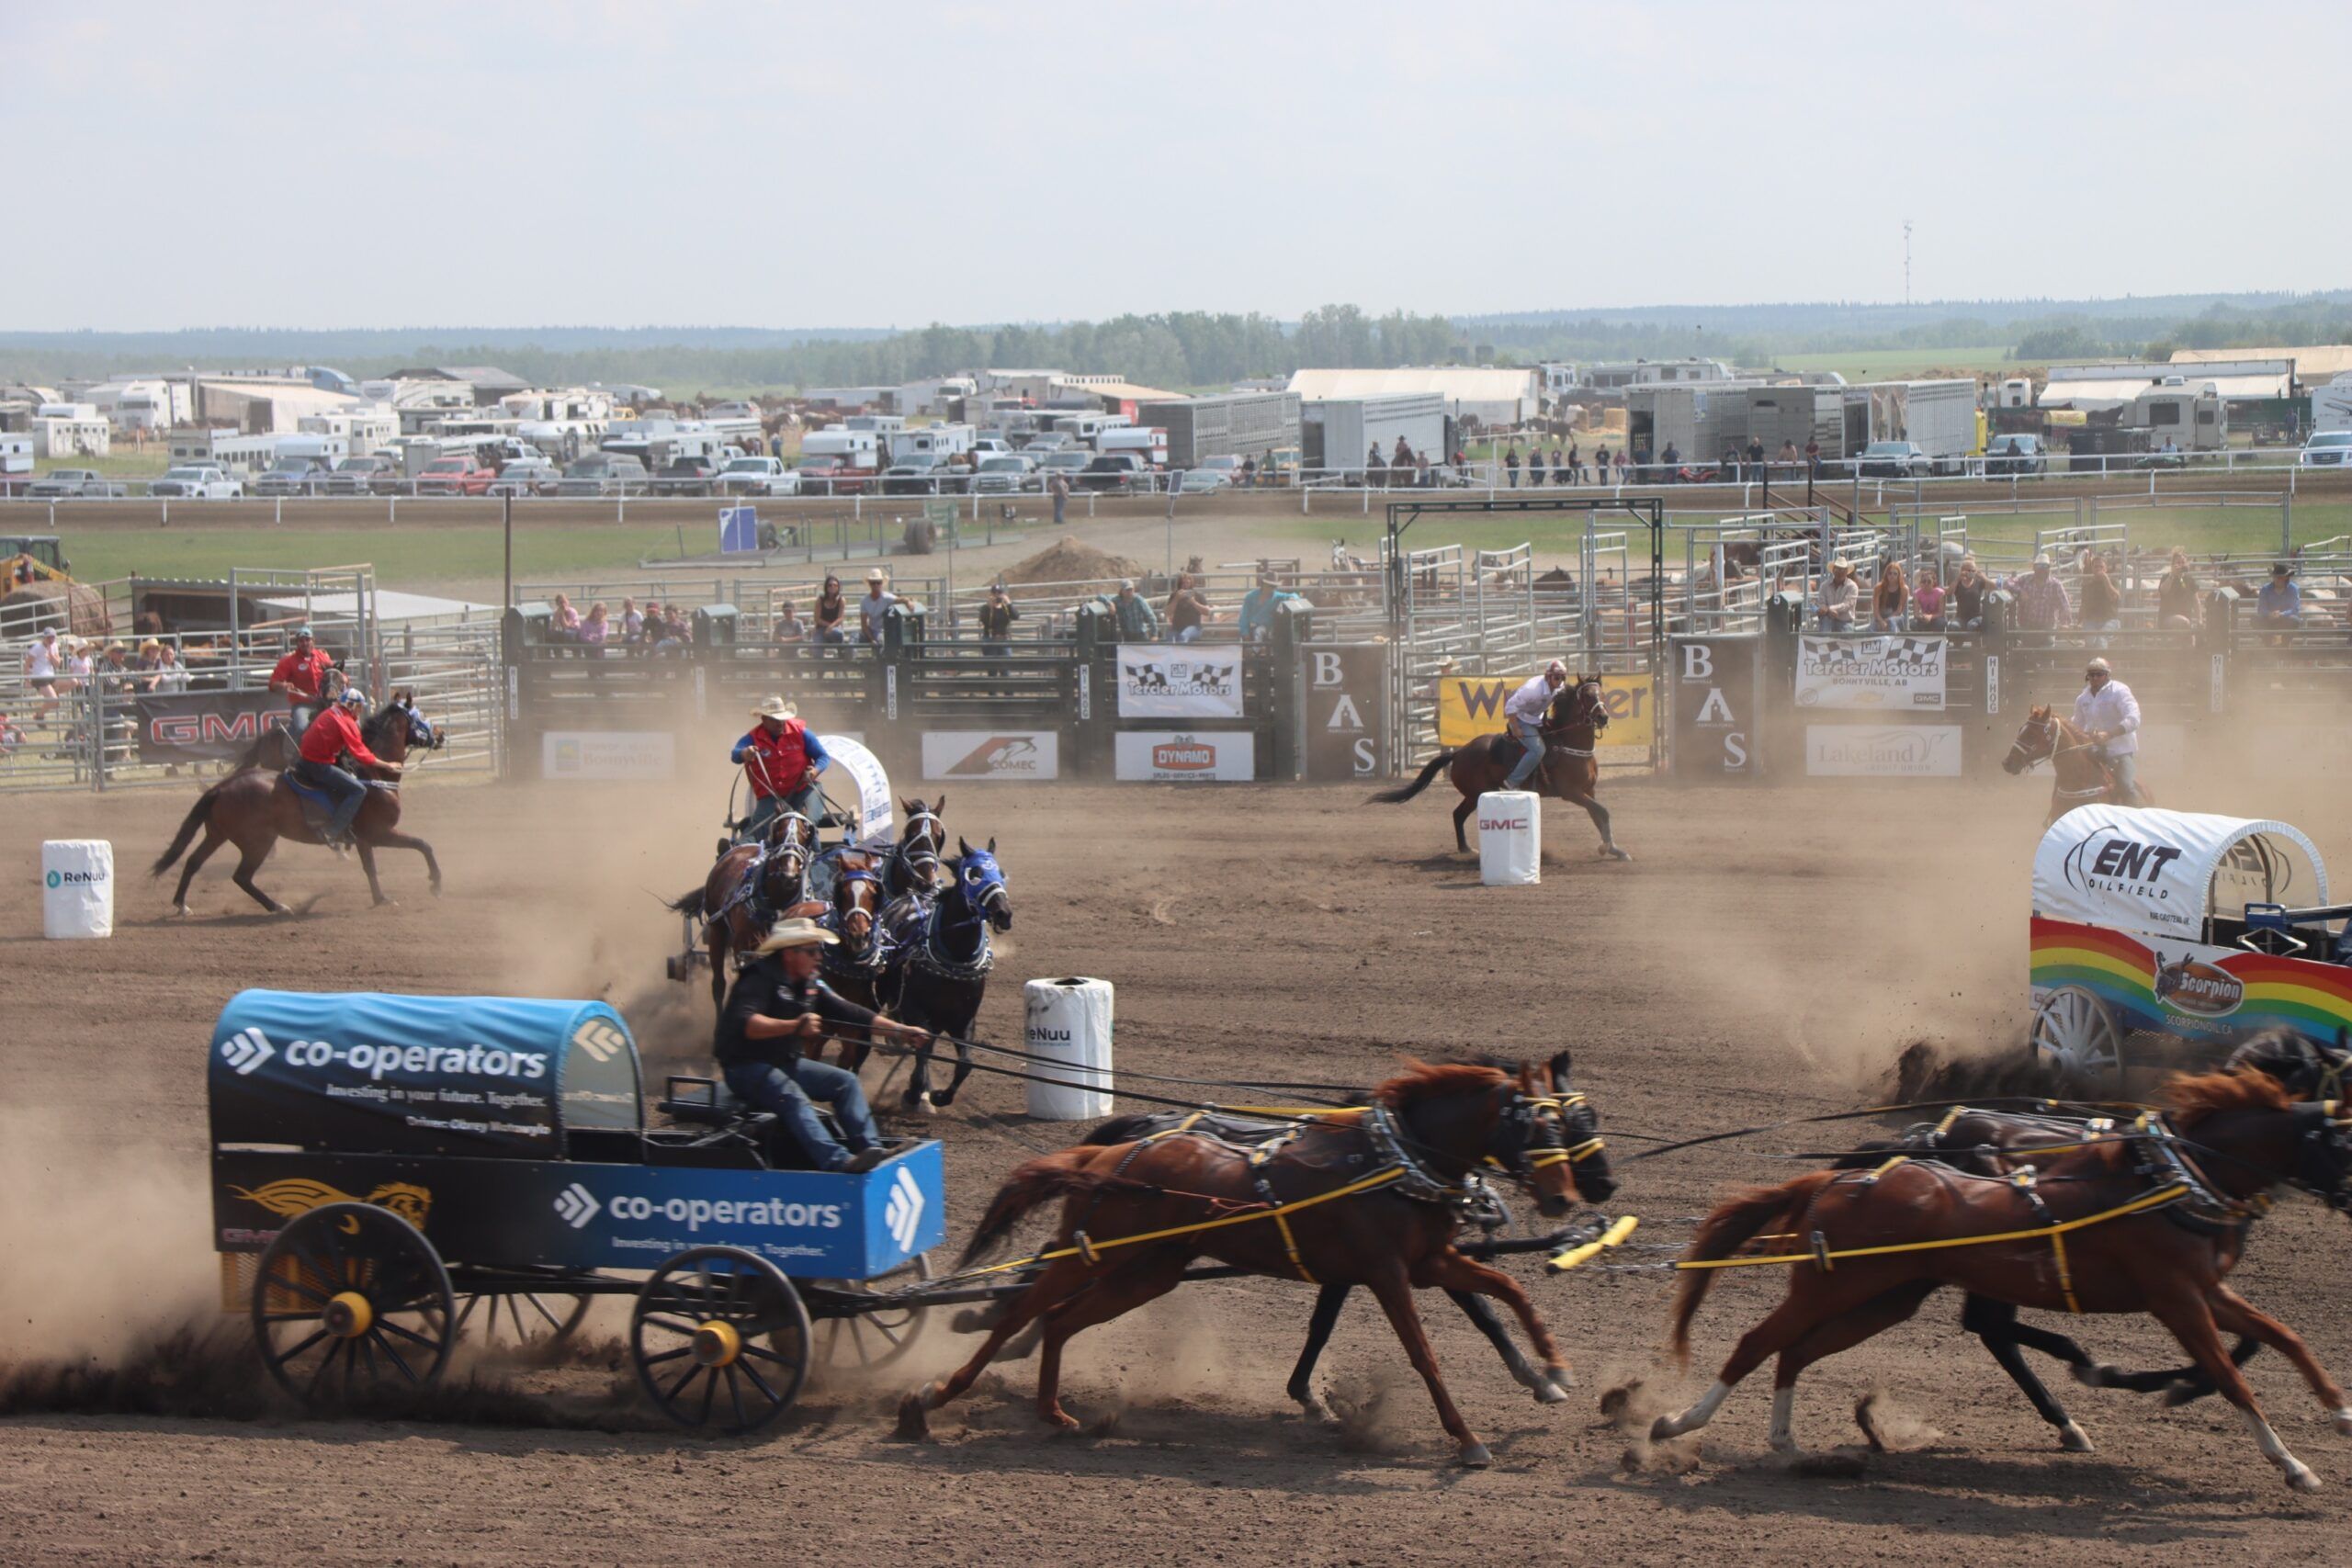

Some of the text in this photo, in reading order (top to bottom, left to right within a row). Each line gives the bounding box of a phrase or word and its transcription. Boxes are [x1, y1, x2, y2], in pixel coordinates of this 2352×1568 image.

[1988, 594, 1996, 604] 6
[888, 606, 895, 617] 2
[1080, 606, 1089, 615] 3
[1313, 652, 1343, 685] B
[1681, 645, 1713, 678] B
[1804, 659, 1939, 677] Tercier Motors
[1127, 681, 1231, 695] Tercier Motors
[1894, 678, 1908, 687] AB
[1988, 658, 1996, 712] HI-HOG
[1327, 694, 1364, 727] A
[1695, 687, 1735, 721] A
[1159, 750, 1210, 763] DYNAMO
[1354, 738, 1376, 773] S
[1724, 732, 1747, 768] S
[1816, 744, 1914, 762] Lakeland
[1479, 818, 1528, 830] GMC
[2091, 840, 2182, 882] ENT
[63, 872, 105, 883] ReNuu
[2088, 878, 2169, 899] OILFIELD
[2179, 972, 2241, 999] Scorpion
[1027, 1028, 1070, 1041] eNuu
[285, 1040, 548, 1080] co-operators
[326, 1083, 389, 1103] Investing
[390, 1086, 404, 1100] in
[407, 1090, 436, 1104] your
[438, 1088, 486, 1104] future.
[609, 1196, 842, 1231] co-operators
[612, 1236, 671, 1253] Investing
